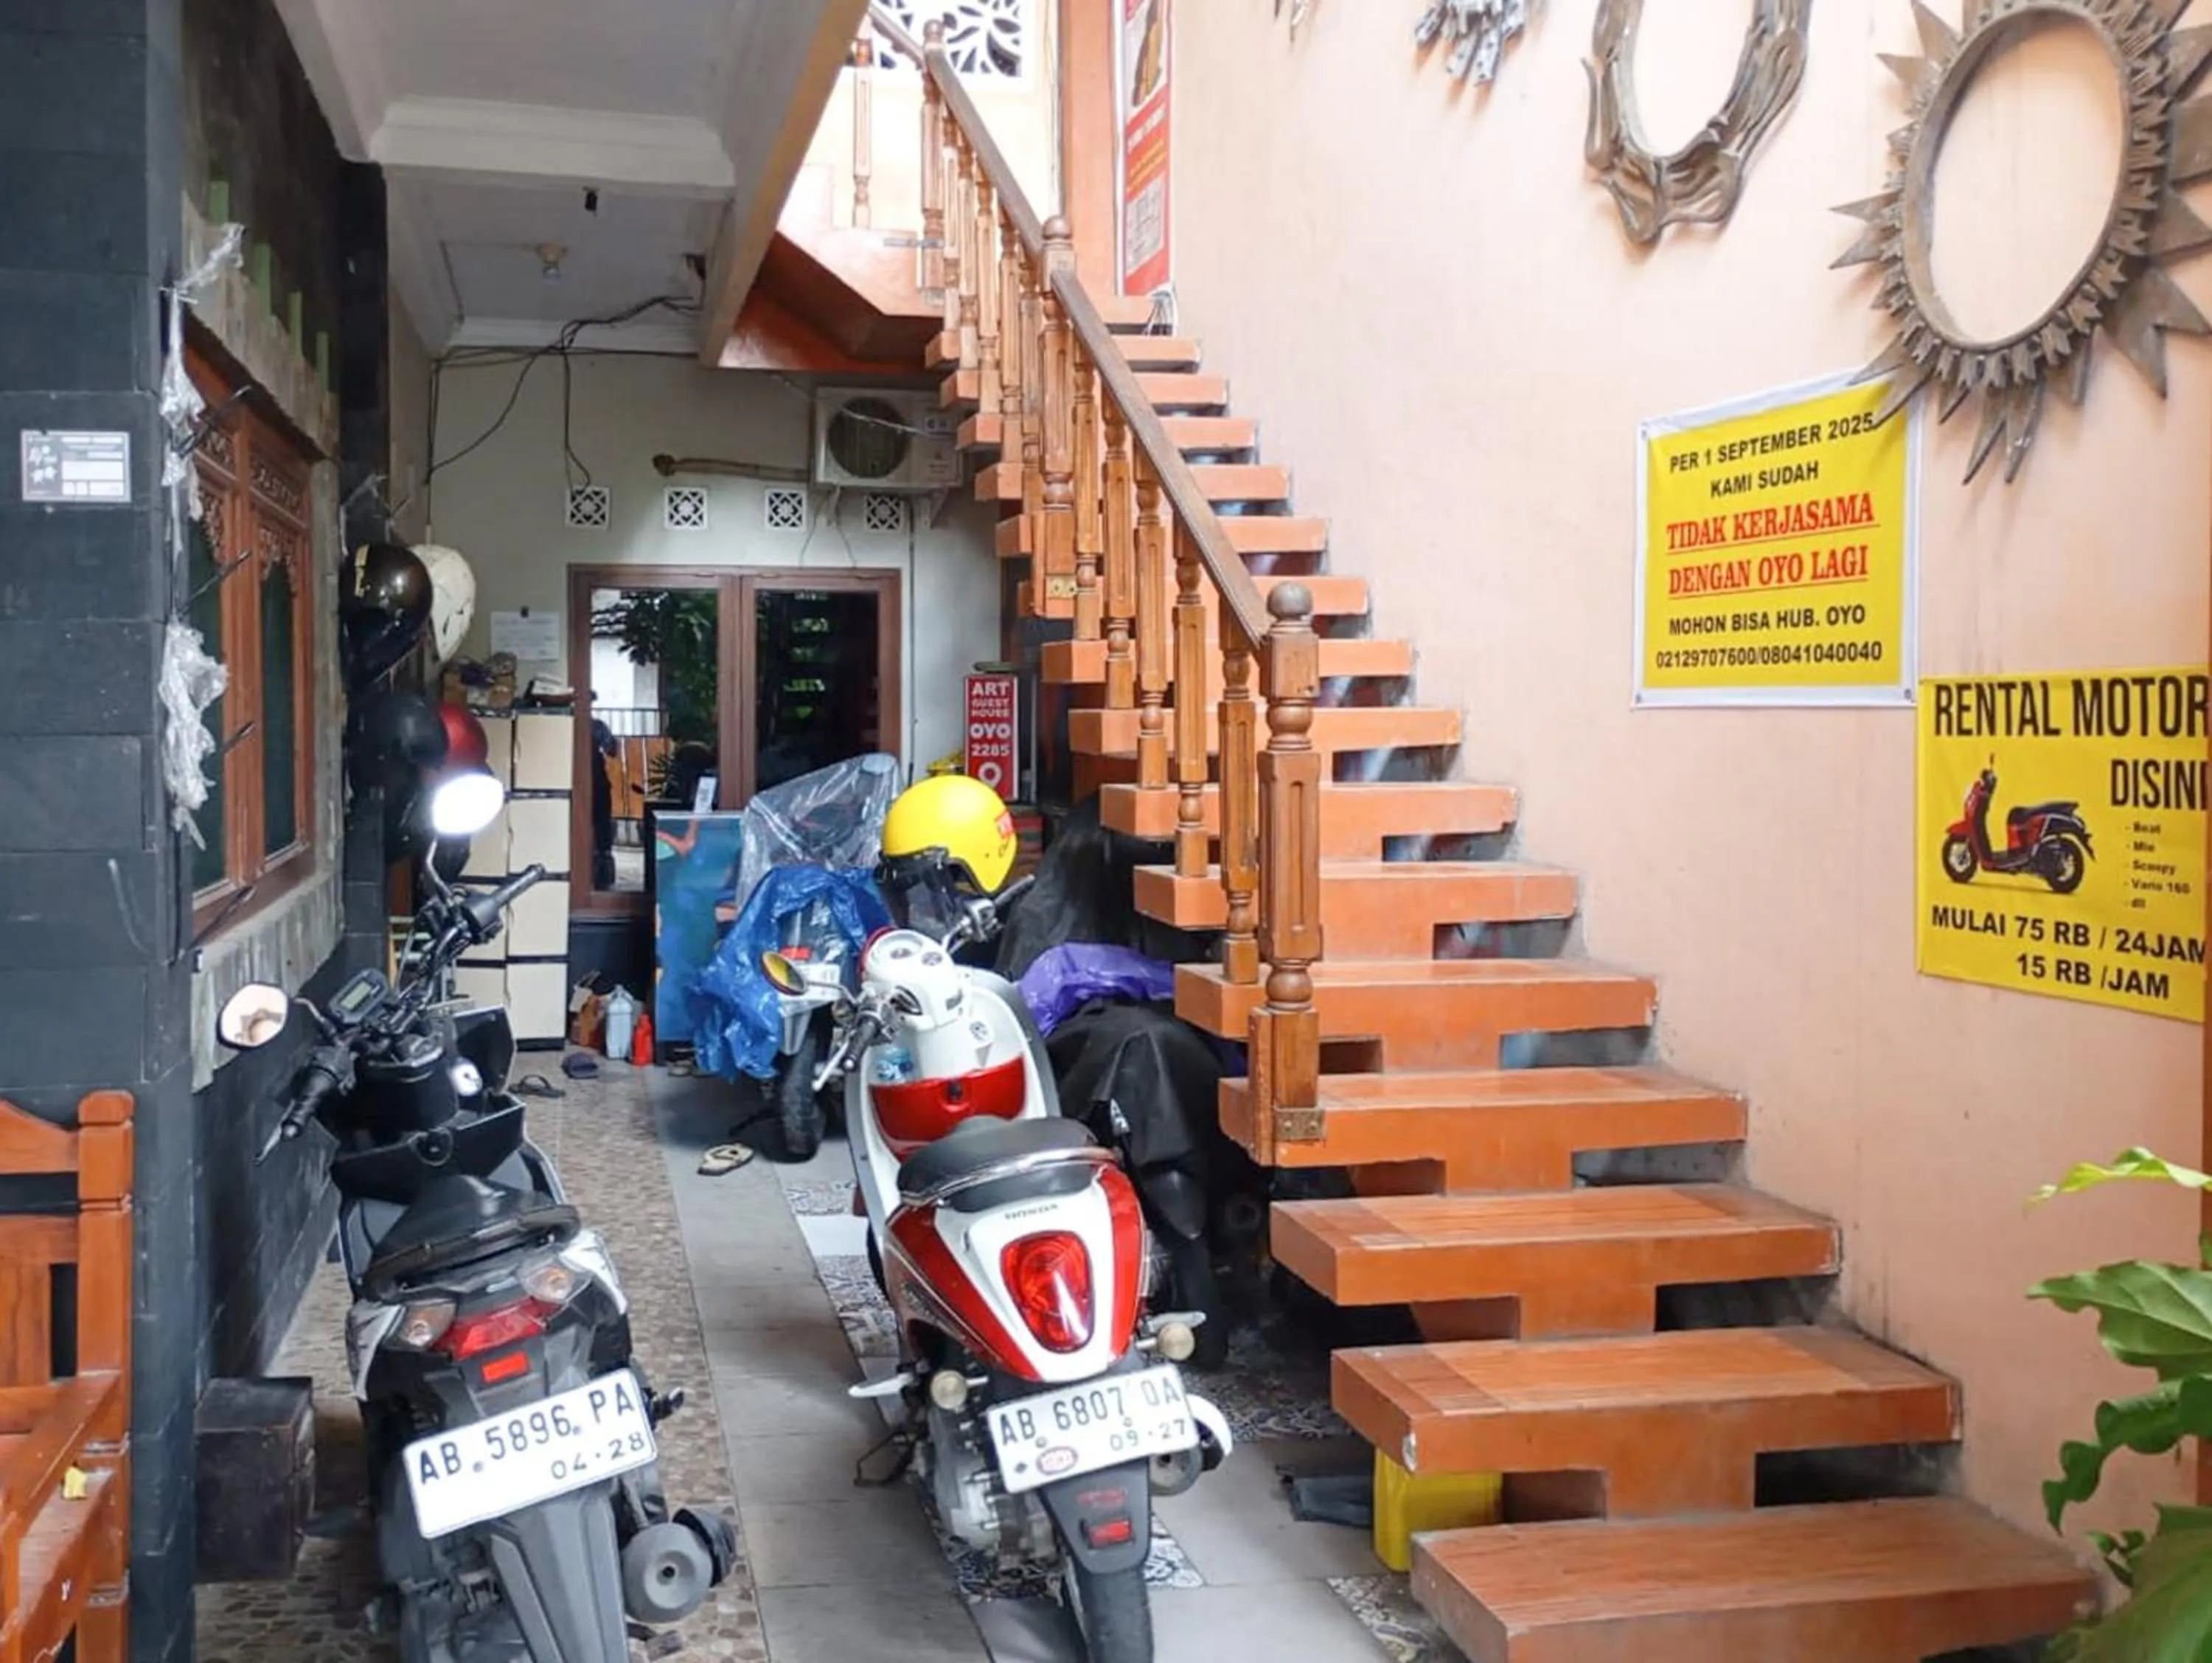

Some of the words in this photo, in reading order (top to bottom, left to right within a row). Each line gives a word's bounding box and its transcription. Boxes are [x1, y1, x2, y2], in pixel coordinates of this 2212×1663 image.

[1670, 452, 1699, 473] PER
[1705, 448, 1711, 466] 1
[1718, 424, 1821, 464] SEPTEMBER
[1829, 412, 1873, 441] 2025
[1711, 475, 1751, 498] KAMI
[1759, 461, 1819, 489] SUDAH
[1666, 515, 1727, 550] TIDAK
[1733, 492, 1874, 540] KERJASAMA
[1669, 559, 1751, 594] DENGAN
[1759, 553, 1804, 586] OYO
[1812, 545, 1868, 580] LAGI
[1669, 615, 1726, 635] MOHON
[1732, 611, 1770, 631] BISA
[1776, 607, 1820, 628] HUB.
[1826, 604, 1865, 625] OYO
[972, 682, 1010, 696] ART
[972, 698, 1010, 708] GUEST
[1935, 679, 2061, 737] RENTAL
[2073, 675, 2208, 737] MOTOR
[970, 723, 1011, 739] OYO
[971, 708, 1010, 717] HOUSE
[2112, 759, 2208, 810] DISINI
[1932, 905, 2006, 935] MULAI
[2014, 916, 2044, 941] 75
[2053, 921, 2090, 947] RB
[2017, 954, 2045, 979] 15
[2056, 959, 2091, 985] RB
[419, 1441, 462, 1485] AB
[484, 1404, 572, 1460] 5896
[588, 1382, 635, 1423] PA
[1000, 1408, 1035, 1446] AB
[1053, 1387, 1124, 1430] 6807
